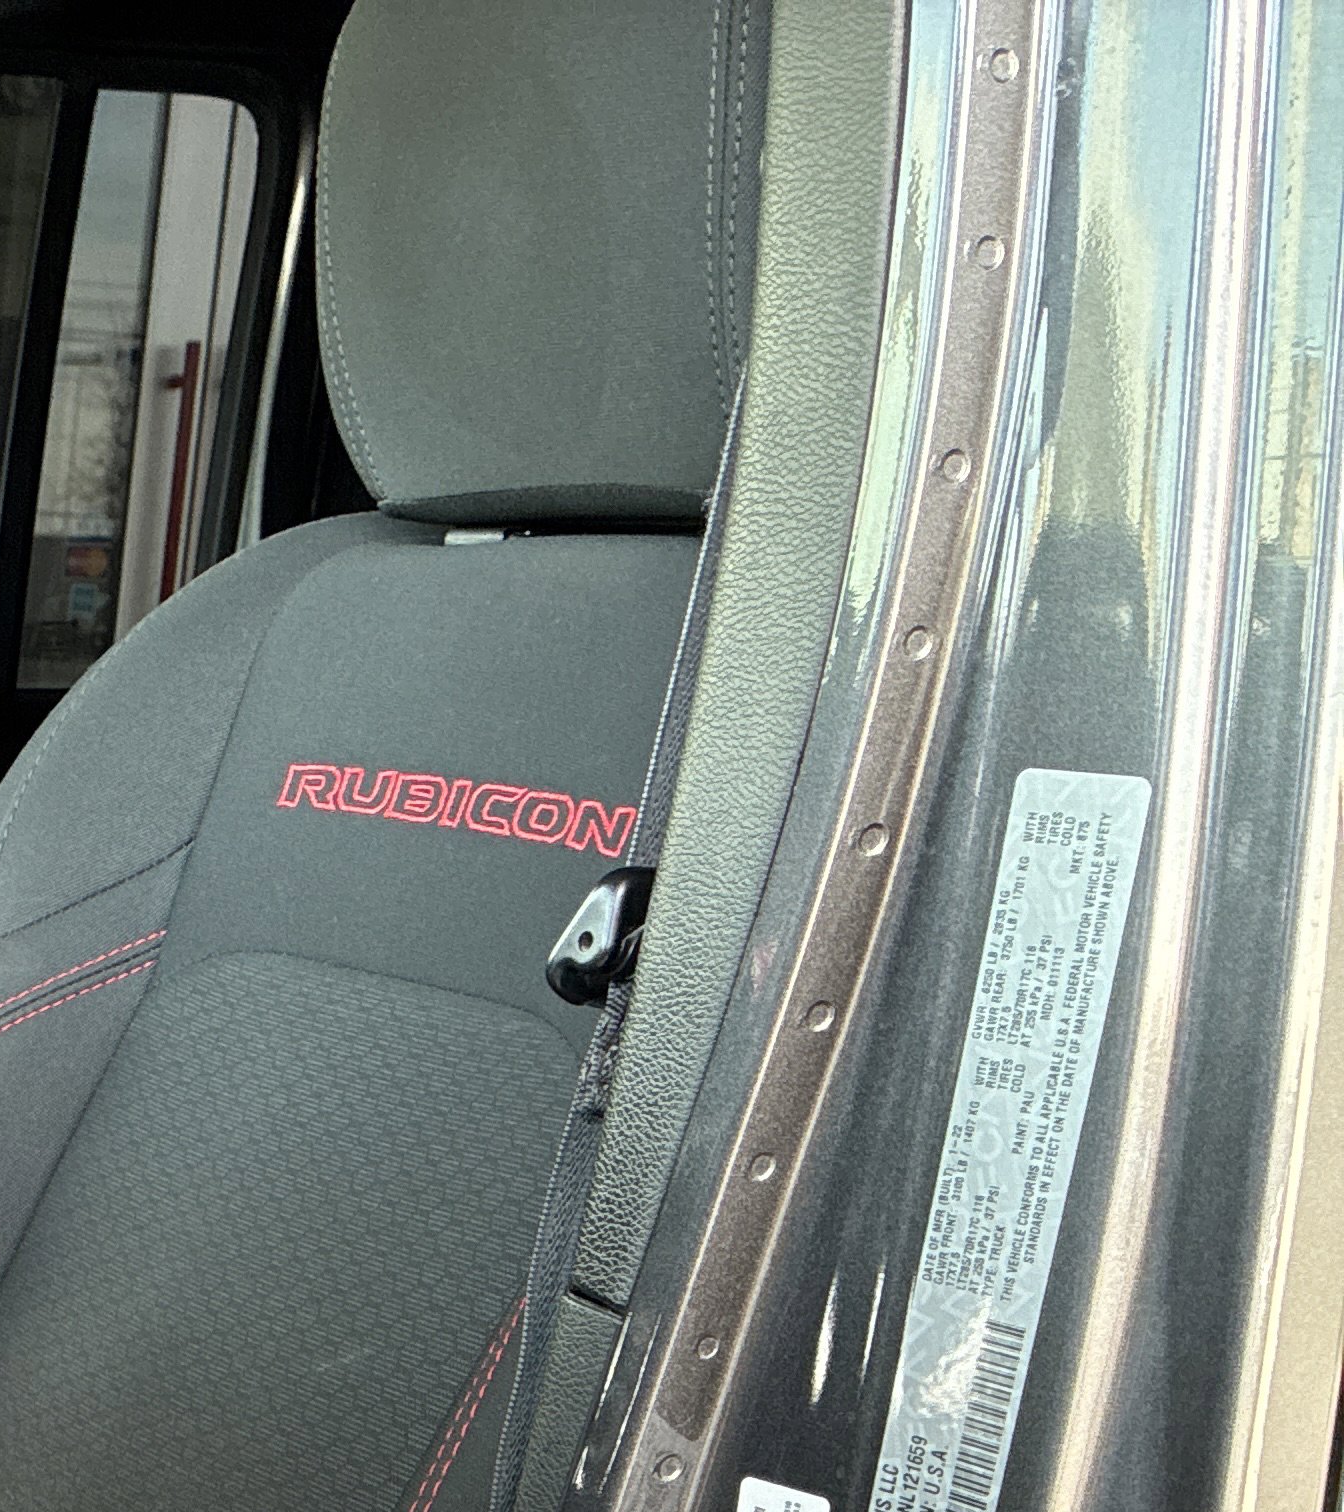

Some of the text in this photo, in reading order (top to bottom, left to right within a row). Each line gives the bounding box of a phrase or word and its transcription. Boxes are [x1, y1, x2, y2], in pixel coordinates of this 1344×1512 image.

[276, 762, 638, 858] RUBICON
[1022, 811, 1039, 842] WITH
[1034, 814, 1050, 843] RIMS
[1047, 811, 1064, 845] TIRES
[1060, 815, 1077, 846] COLD
[1092, 812, 1114, 857] SAFETY
[1016, 855, 1030, 871] KG
[1081, 860, 1104, 909] VEHICLE
[985, 950, 998, 964] LB
[997, 889, 1011, 905] KG
[1004, 917, 1017, 931] LB
[1072, 911, 1093, 953] MOTOR
[1090, 900, 1111, 945] SHOWN
[1038, 933, 1053, 953] PSI
[1034, 956, 1048, 970] 37
[1061, 956, 1084, 1008] FEDERAL
[1071, 948, 1101, 1035] MANUFACTURE
[982, 1006, 999, 1041] GAWR
[1018, 1032, 1032, 1048] AT
[1067, 1039, 1082, 1054] OF
[973, 1055, 989, 1086] WITH
[984, 1059, 1000, 1089] RIMS
[996, 1057, 1014, 1091] TIRES
[1037, 1050, 1064, 1120] APPLICABLE
[1060, 1057, 1078, 1087] DATE
[967, 1100, 980, 1116] KG
[1054, 1090, 1071, 1113] THE
[1033, 1121, 1049, 1143] ALL
[1050, 1115, 1066, 1134] ON
[955, 1158, 968, 1173] LB
[1029, 1146, 1044, 1161] TO
[1041, 1136, 1061, 1177] EFFECT
[968, 1279, 980, 1294] AT
[986, 1184, 1000, 1203] PSI
[1009, 1063, 1026, 1093] COLD
[989, 1224, 1007, 1262] TRUCK
[1019, 1089, 1035, 1114] PAU
[1038, 1180, 1052, 1193] IN
[1015, 1164, 1040, 1226] CONFORMS
[931, 1208, 946, 1232] MFR
[1023, 1196, 1049, 1264] STANDARDS
[928, 1235, 940, 1251] OF
[1005, 1228, 1027, 1274] VEHICLE
[921, 1252, 937, 1281] DATE
[933, 1250, 949, 1285] GAWR
[999, 1276, 1017, 1303] THIS
[878, 1462, 898, 1494] LLC
[922, 1441, 949, 1496] U.S.A.
